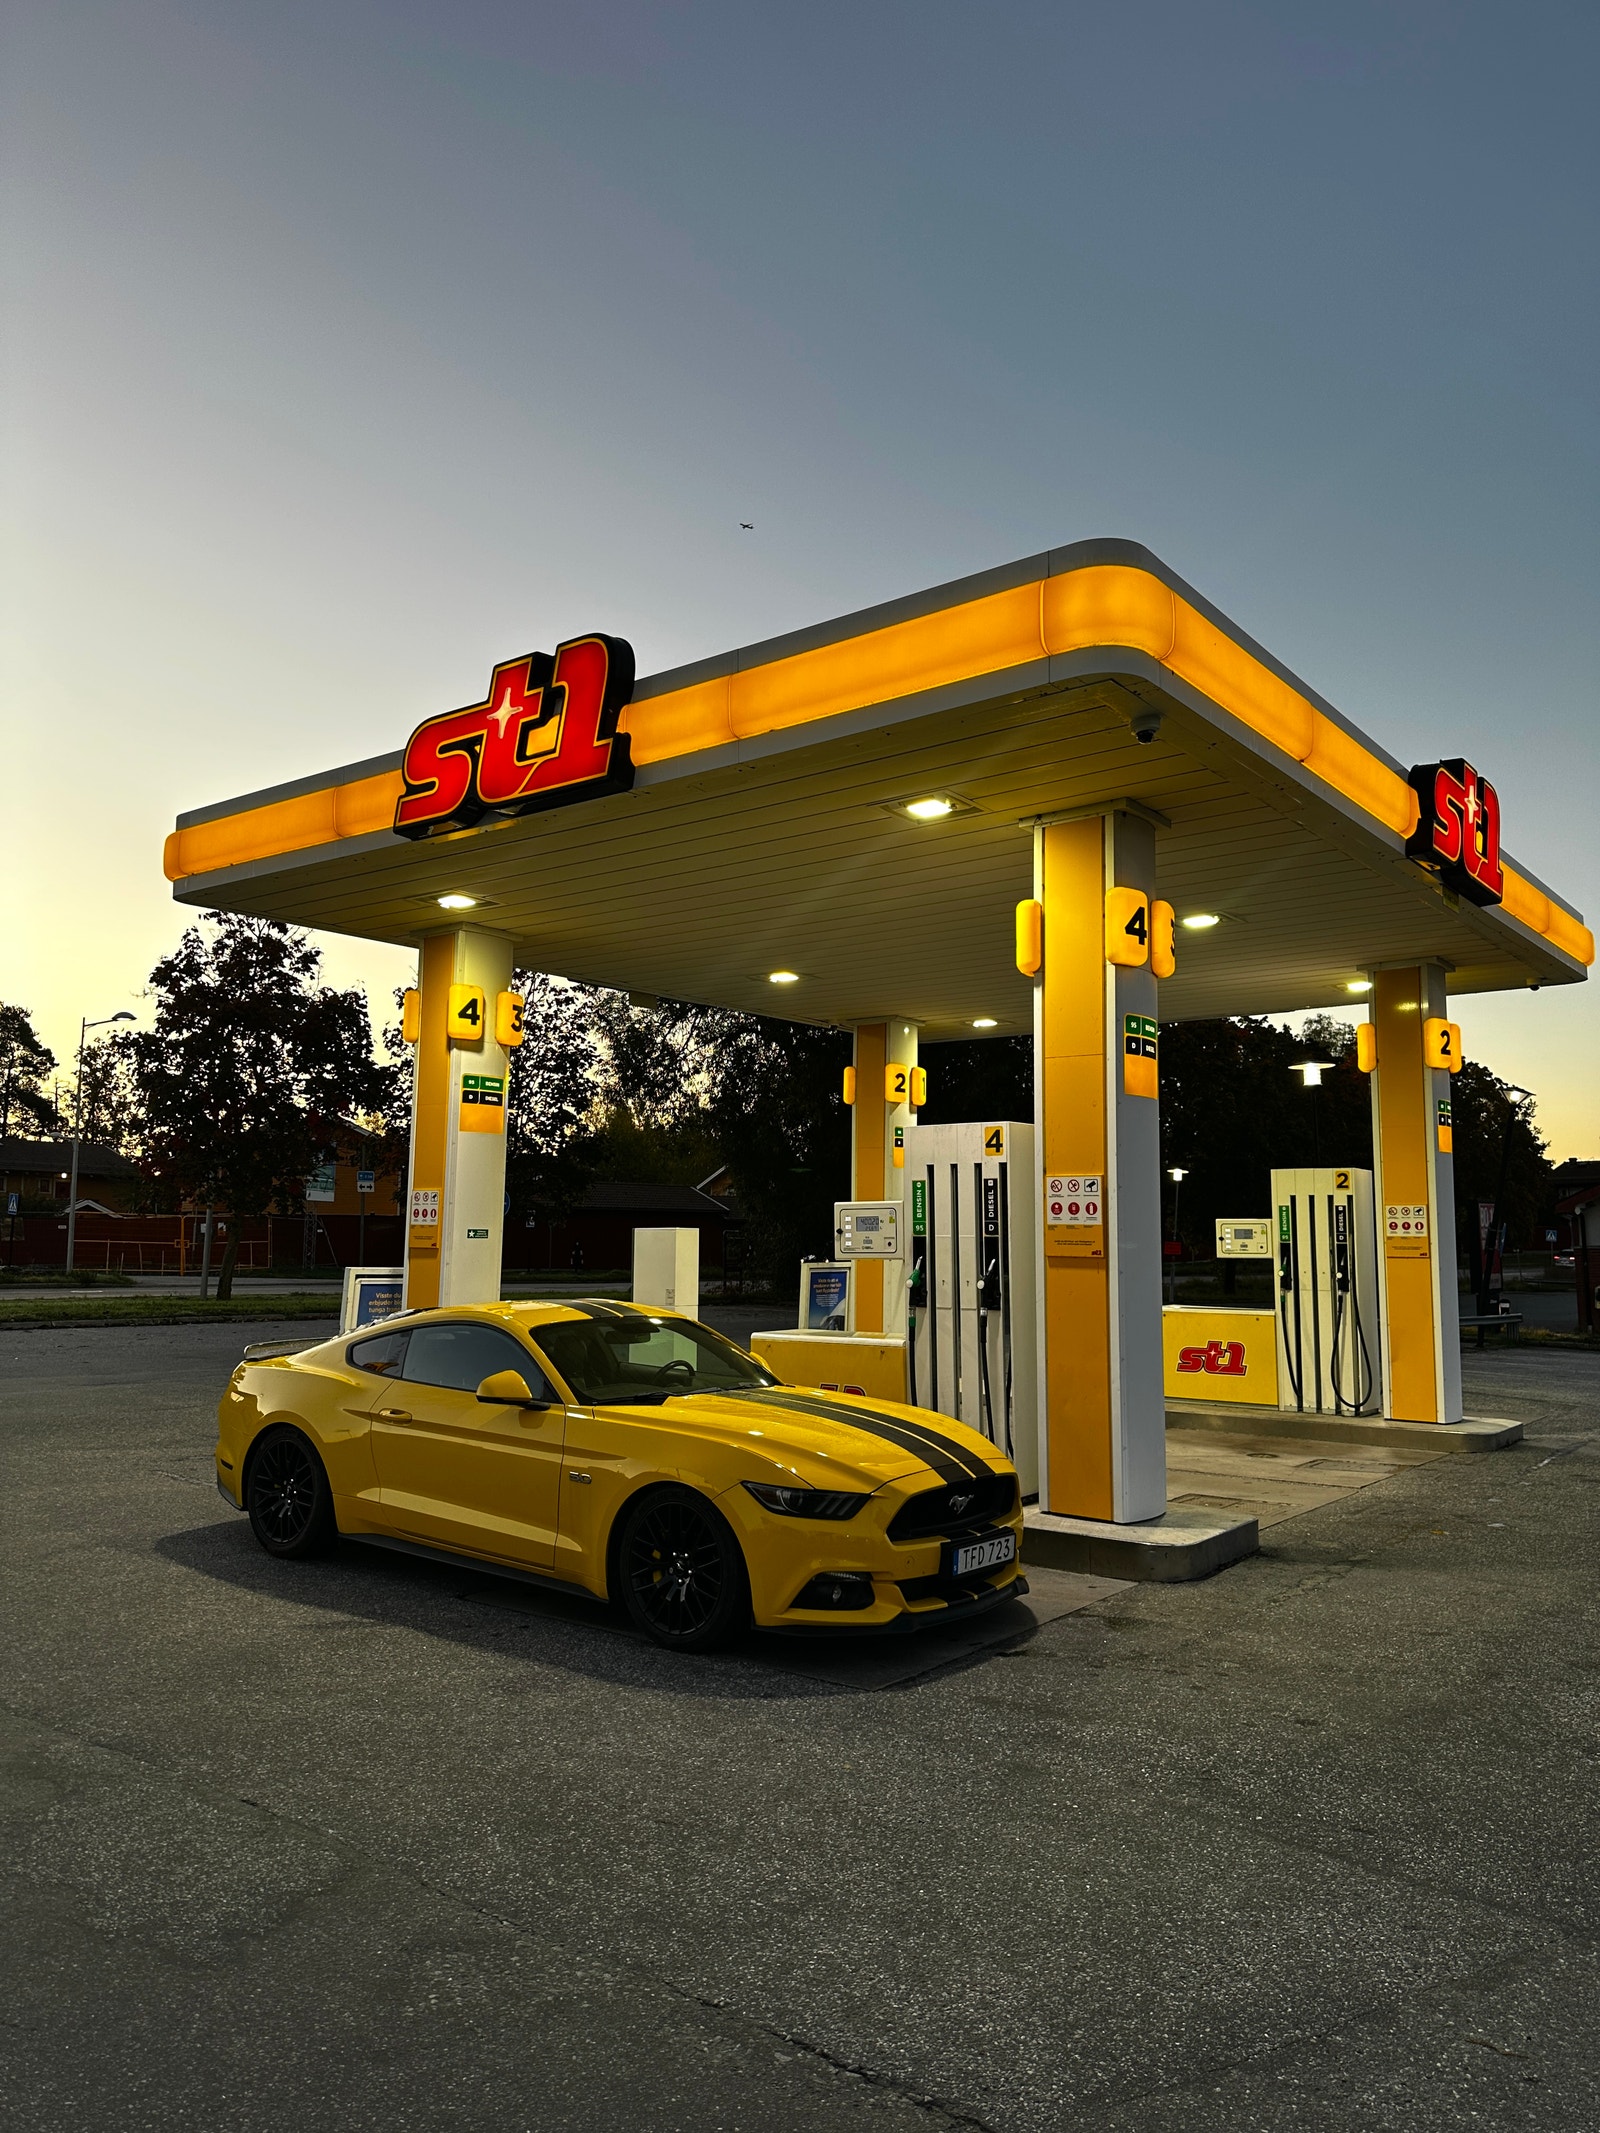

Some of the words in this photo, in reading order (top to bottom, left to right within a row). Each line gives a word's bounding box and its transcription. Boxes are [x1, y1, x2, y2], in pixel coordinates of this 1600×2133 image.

[395, 636, 614, 828] st1
[1432, 761, 1503, 898] st1
[1124, 906, 1147, 946] 4
[458, 998, 480, 1026] 4
[511, 1004, 523, 1032] 3
[1440, 1030, 1451, 1055] 2
[894, 1072, 906, 1093] 2
[985, 1129, 1003, 1153] 4
[1336, 1172, 1349, 1188] 2
[1176, 1340, 1248, 1376] st1
[963, 1545, 985, 1569] TFD
[989, 1538, 1010, 1562] 723
